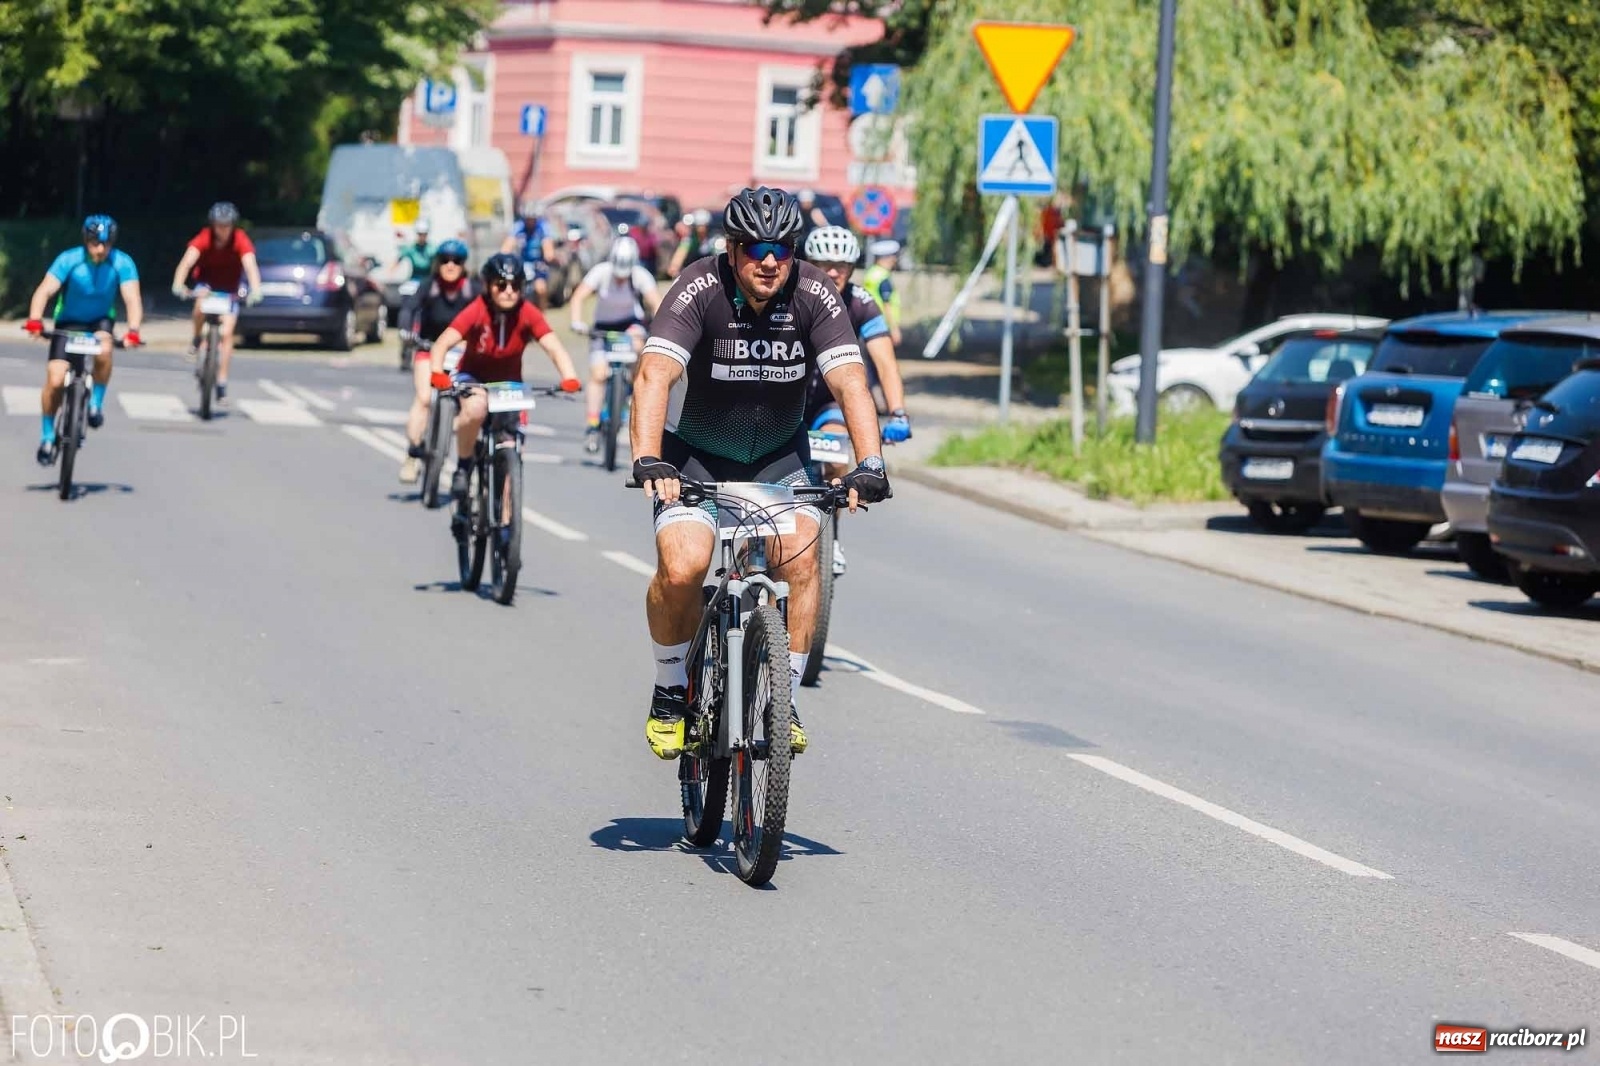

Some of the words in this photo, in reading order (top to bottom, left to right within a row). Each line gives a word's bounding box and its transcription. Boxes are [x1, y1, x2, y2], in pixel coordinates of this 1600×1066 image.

[677, 272, 719, 305] BORA
[809, 280, 842, 319] BORA
[734, 339, 805, 361] BORA
[728, 365, 798, 380] hansgrohe
